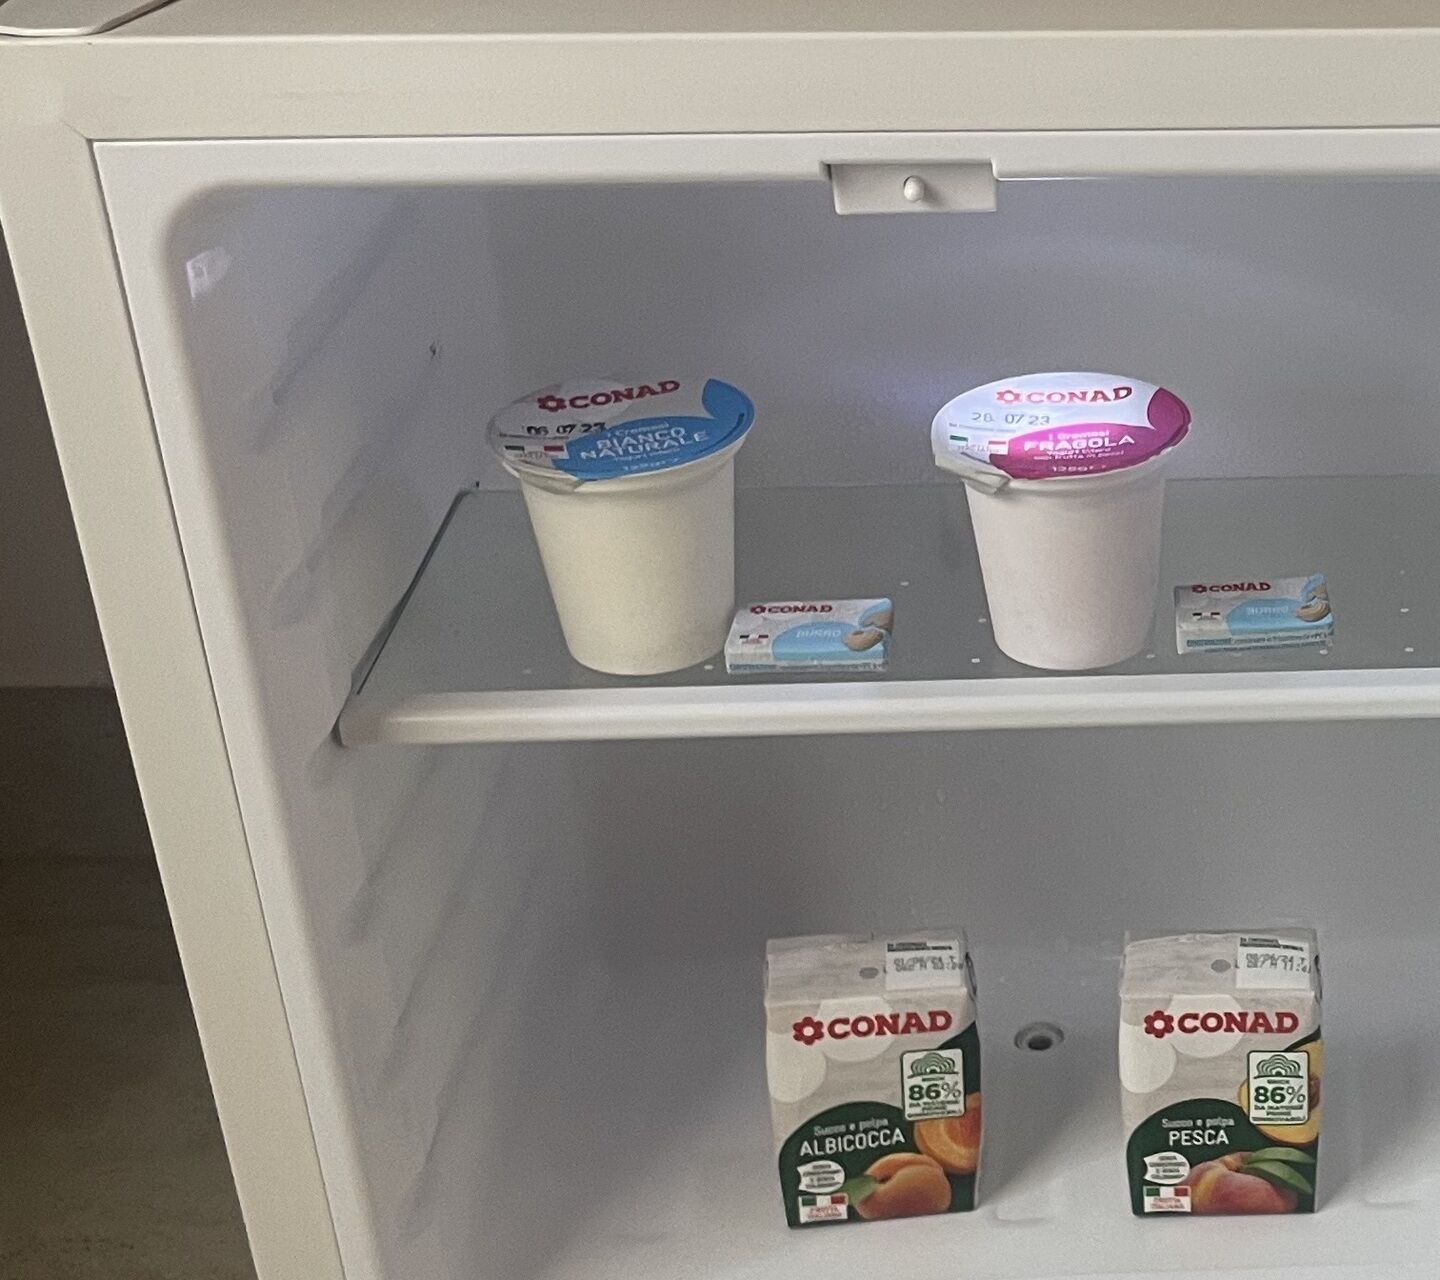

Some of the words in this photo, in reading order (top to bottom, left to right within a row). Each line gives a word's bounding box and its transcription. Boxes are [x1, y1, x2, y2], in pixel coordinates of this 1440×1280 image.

[569, 379, 681, 410] CONAD
[1025, 386, 1133, 404] CONAD
[1004, 413, 1026, 425] 07
[580, 430, 710, 460] NATURALE
[596, 426, 686, 450] BIANCO
[1024, 434, 1136, 452] FRAGOLA
[1208, 581, 1272, 593] CONAD
[767, 604, 833, 615] CONAD
[827, 1009, 953, 1040] CONAD
[1177, 1011, 1300, 1035] CONAD
[908, 1080, 962, 1101] 86%
[1253, 1084, 1307, 1105] 86%
[799, 1127, 906, 1157] ALBICOCCA
[1168, 1129, 1230, 1147] PESCA
